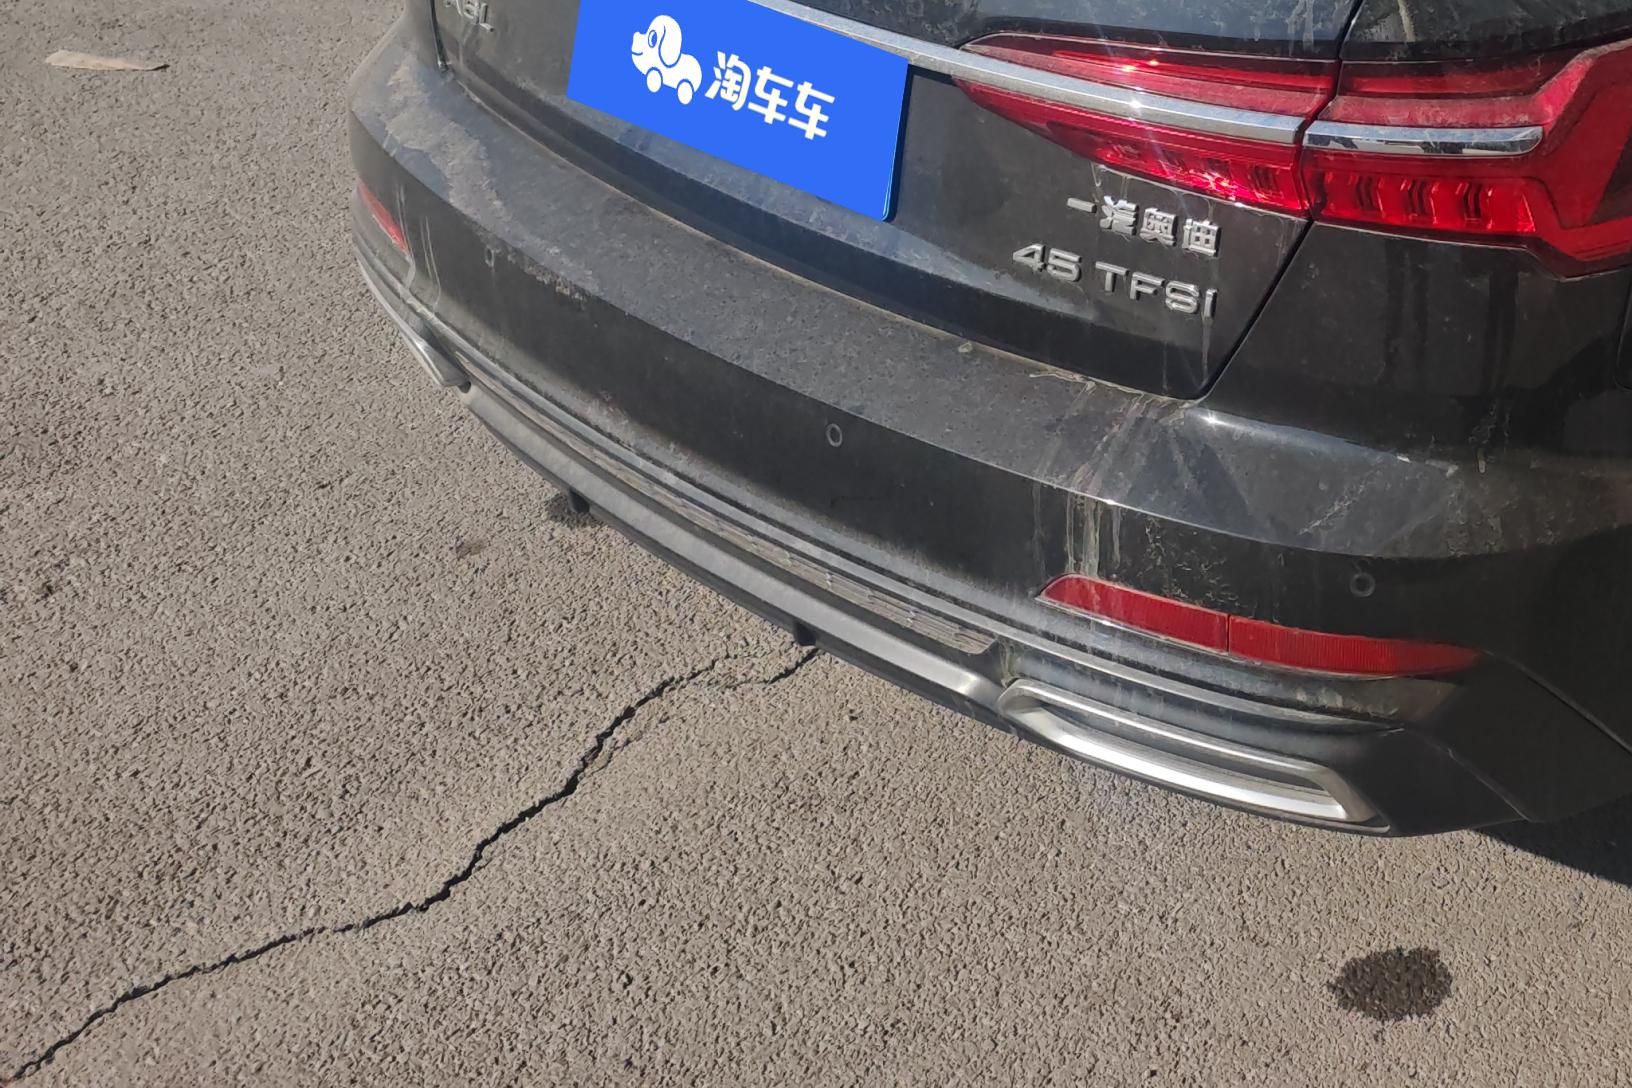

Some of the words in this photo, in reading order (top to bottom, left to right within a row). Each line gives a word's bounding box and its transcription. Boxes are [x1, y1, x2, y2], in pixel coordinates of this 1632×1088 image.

[1067, 196, 1221, 256] 一汽奥迪
[1012, 243, 1082, 282] 45
[1096, 261, 1218, 318] TFSI
